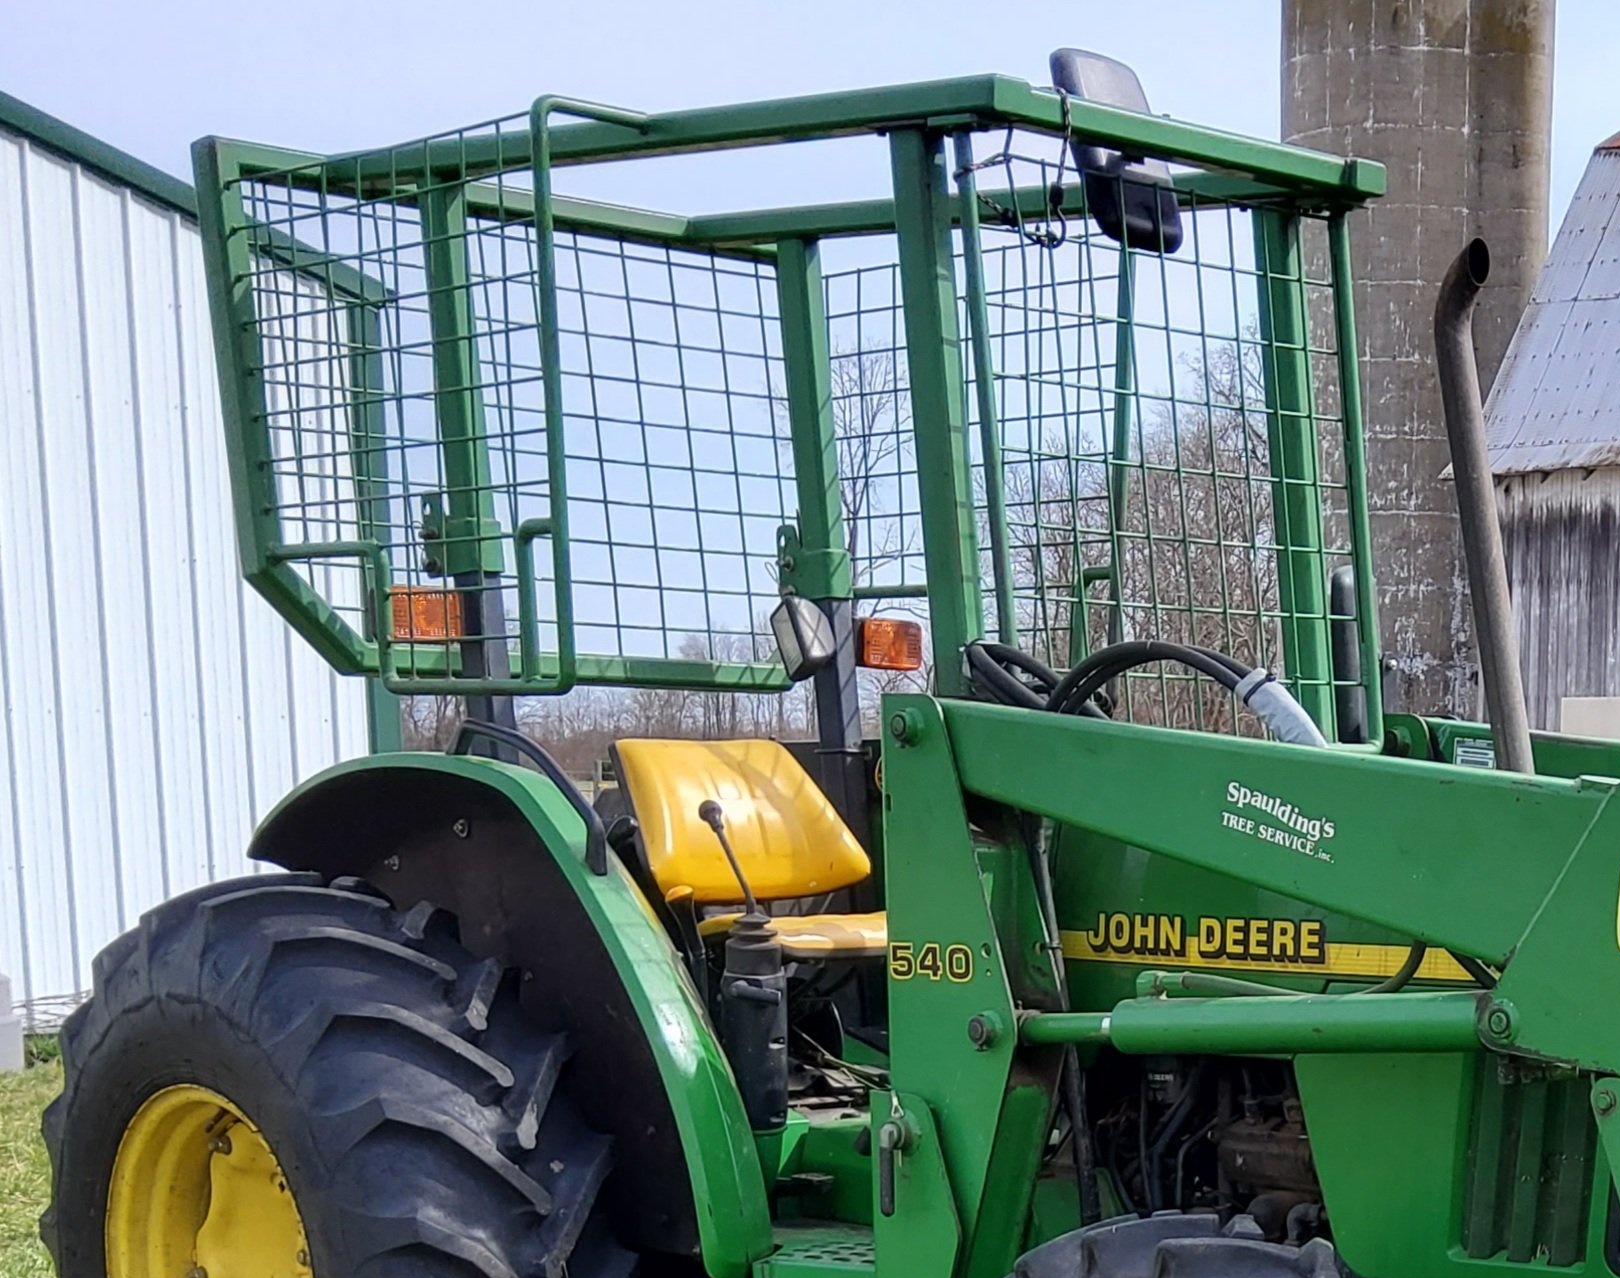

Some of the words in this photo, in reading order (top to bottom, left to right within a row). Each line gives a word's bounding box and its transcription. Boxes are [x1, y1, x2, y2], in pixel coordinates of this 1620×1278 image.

[1221, 811, 1255, 835] TREE
[1226, 781, 1335, 841] Spaulding's
[1087, 911, 1186, 957] JOHN
[1198, 916, 1326, 963] DEERE
[889, 942, 973, 983] 540
